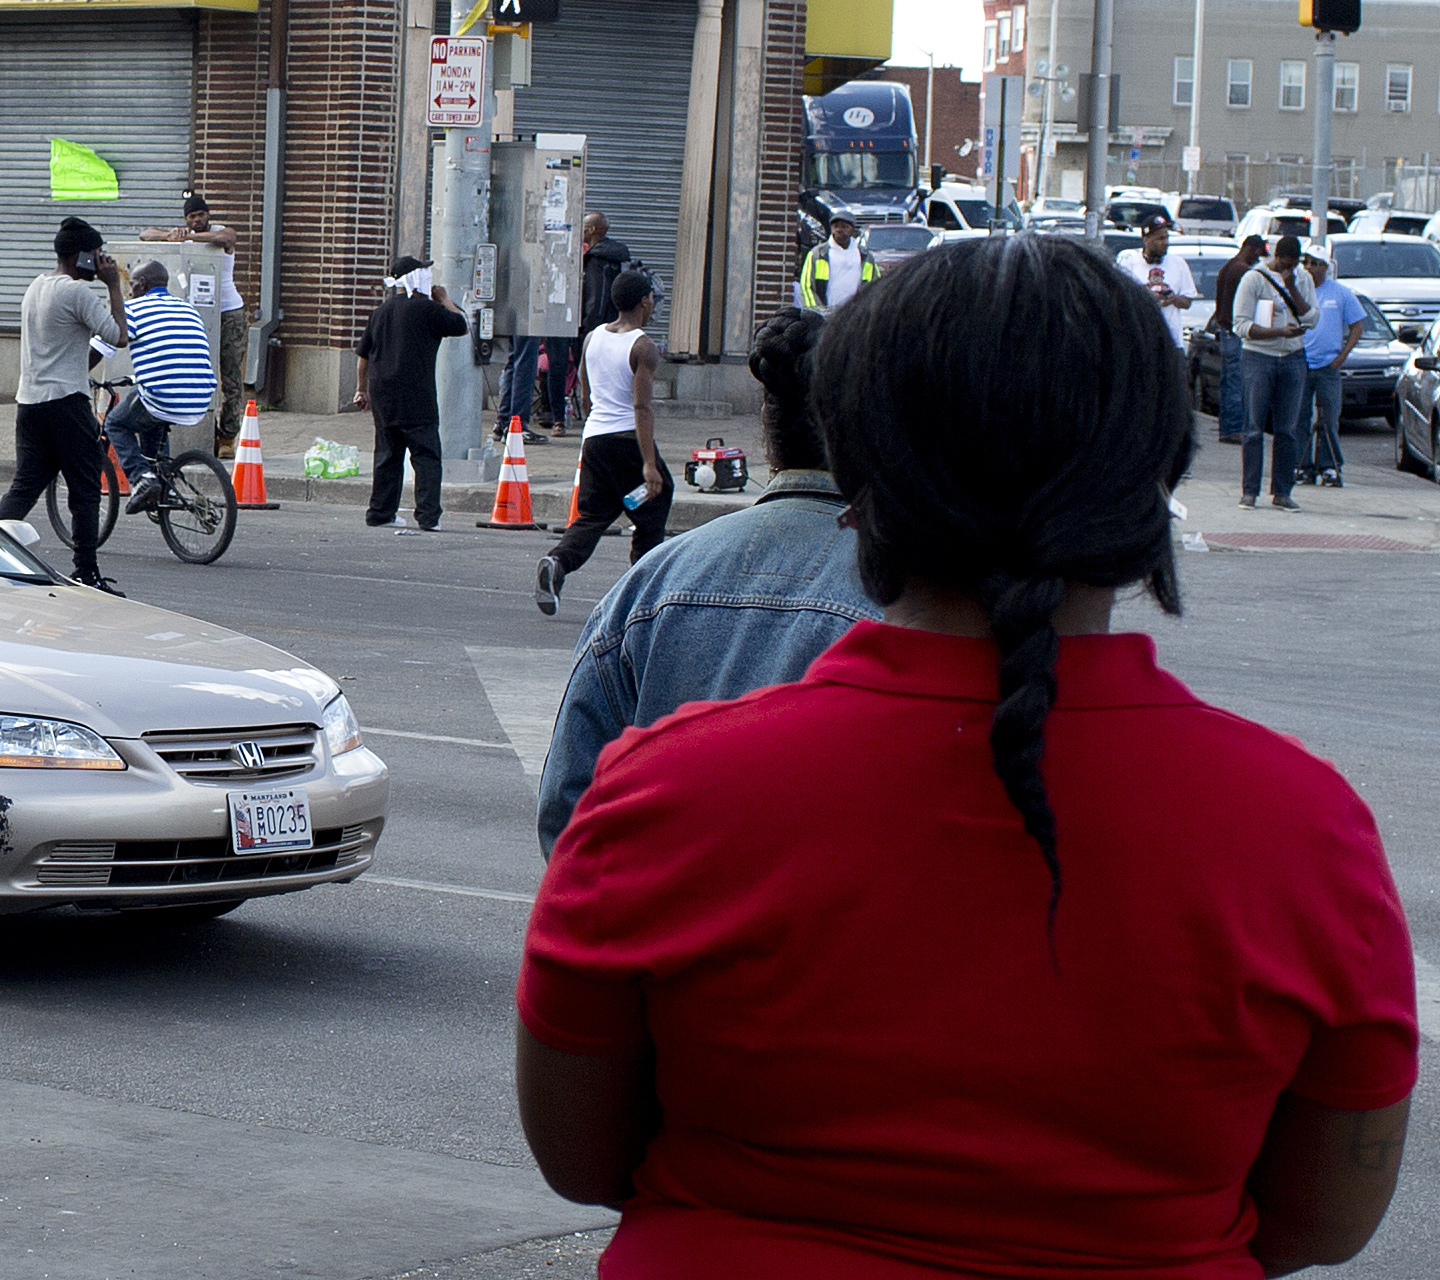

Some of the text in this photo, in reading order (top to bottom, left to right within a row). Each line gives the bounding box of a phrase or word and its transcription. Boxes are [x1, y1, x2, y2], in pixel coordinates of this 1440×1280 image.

[432, 42, 481, 60] NO PARKING
[440, 66, 473, 78] MONDAY
[250, 793, 288, 801] MARYLAND
